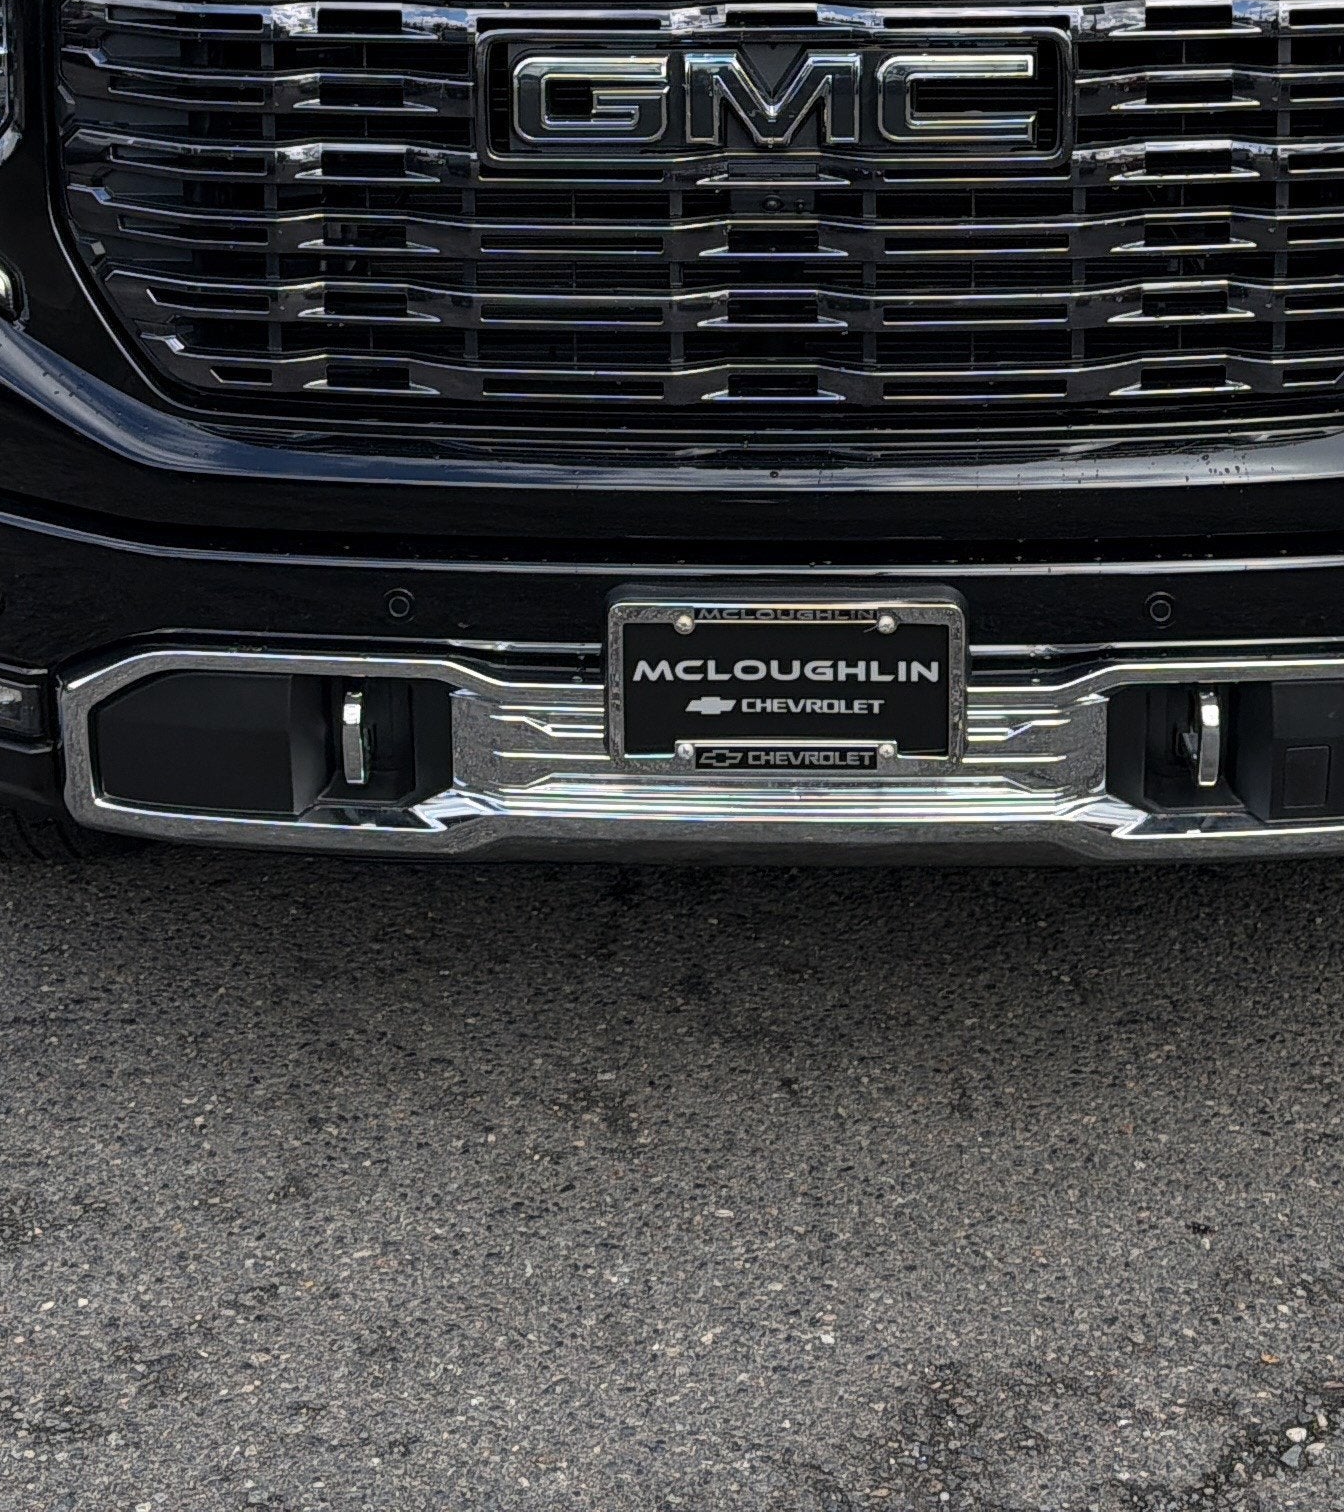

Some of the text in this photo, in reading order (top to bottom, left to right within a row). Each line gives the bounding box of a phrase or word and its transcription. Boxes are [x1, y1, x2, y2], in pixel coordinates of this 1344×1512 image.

[512, 51, 1037, 147] GMC
[698, 608, 875, 621] MCLOUGHLIN
[632, 659, 939, 683] MCLOUGHLIN
[741, 698, 885, 715] CHEVROLET
[747, 751, 875, 766] CHEVROLET
